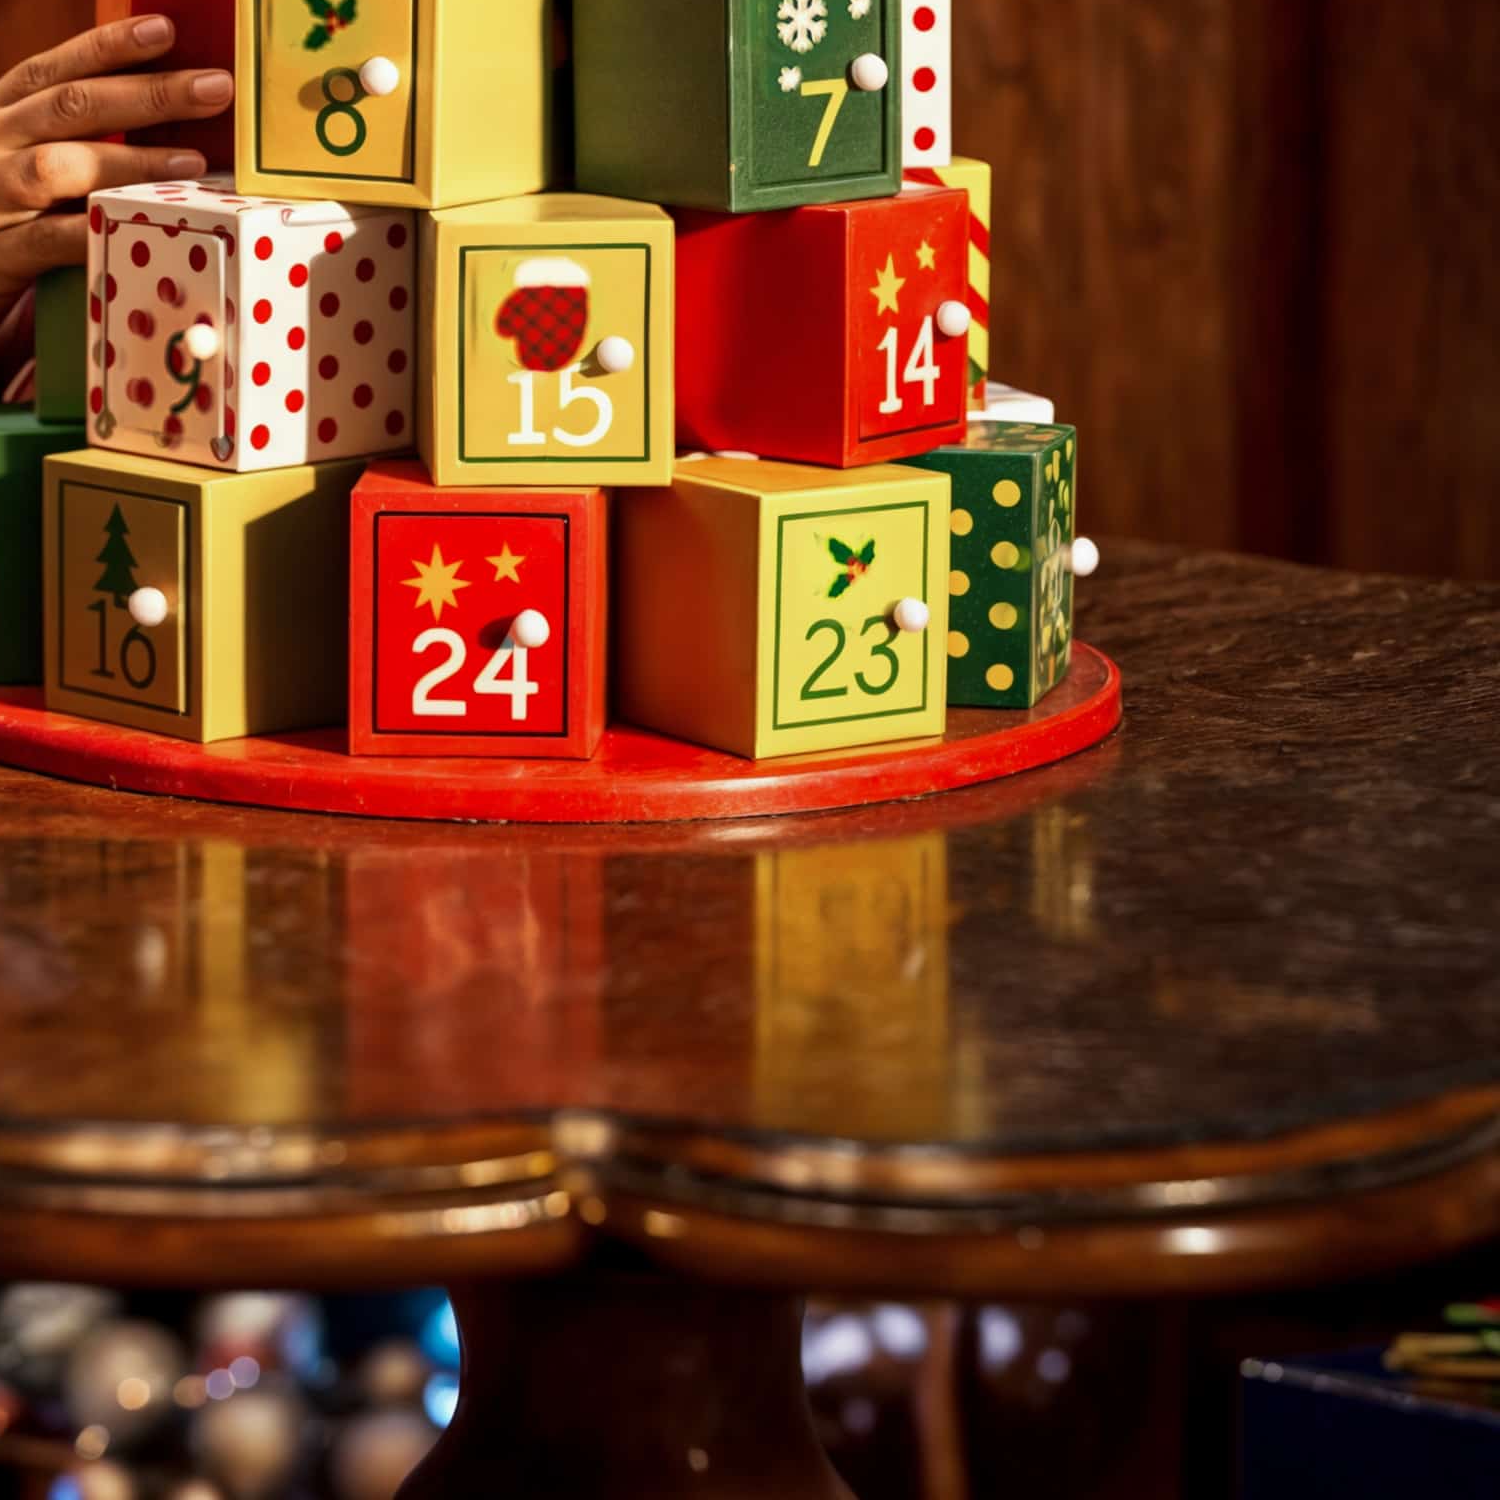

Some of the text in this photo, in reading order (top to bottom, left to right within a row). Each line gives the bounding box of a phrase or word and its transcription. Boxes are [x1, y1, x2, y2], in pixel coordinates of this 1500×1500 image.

[316, 67, 366, 156] 8
[801, 78, 848, 167] 7
[165, 331, 202, 414] 9
[506, 362, 613, 447] 15
[875, 315, 941, 414] 14
[412, 626, 539, 721] 24
[800, 614, 900, 700] 23
